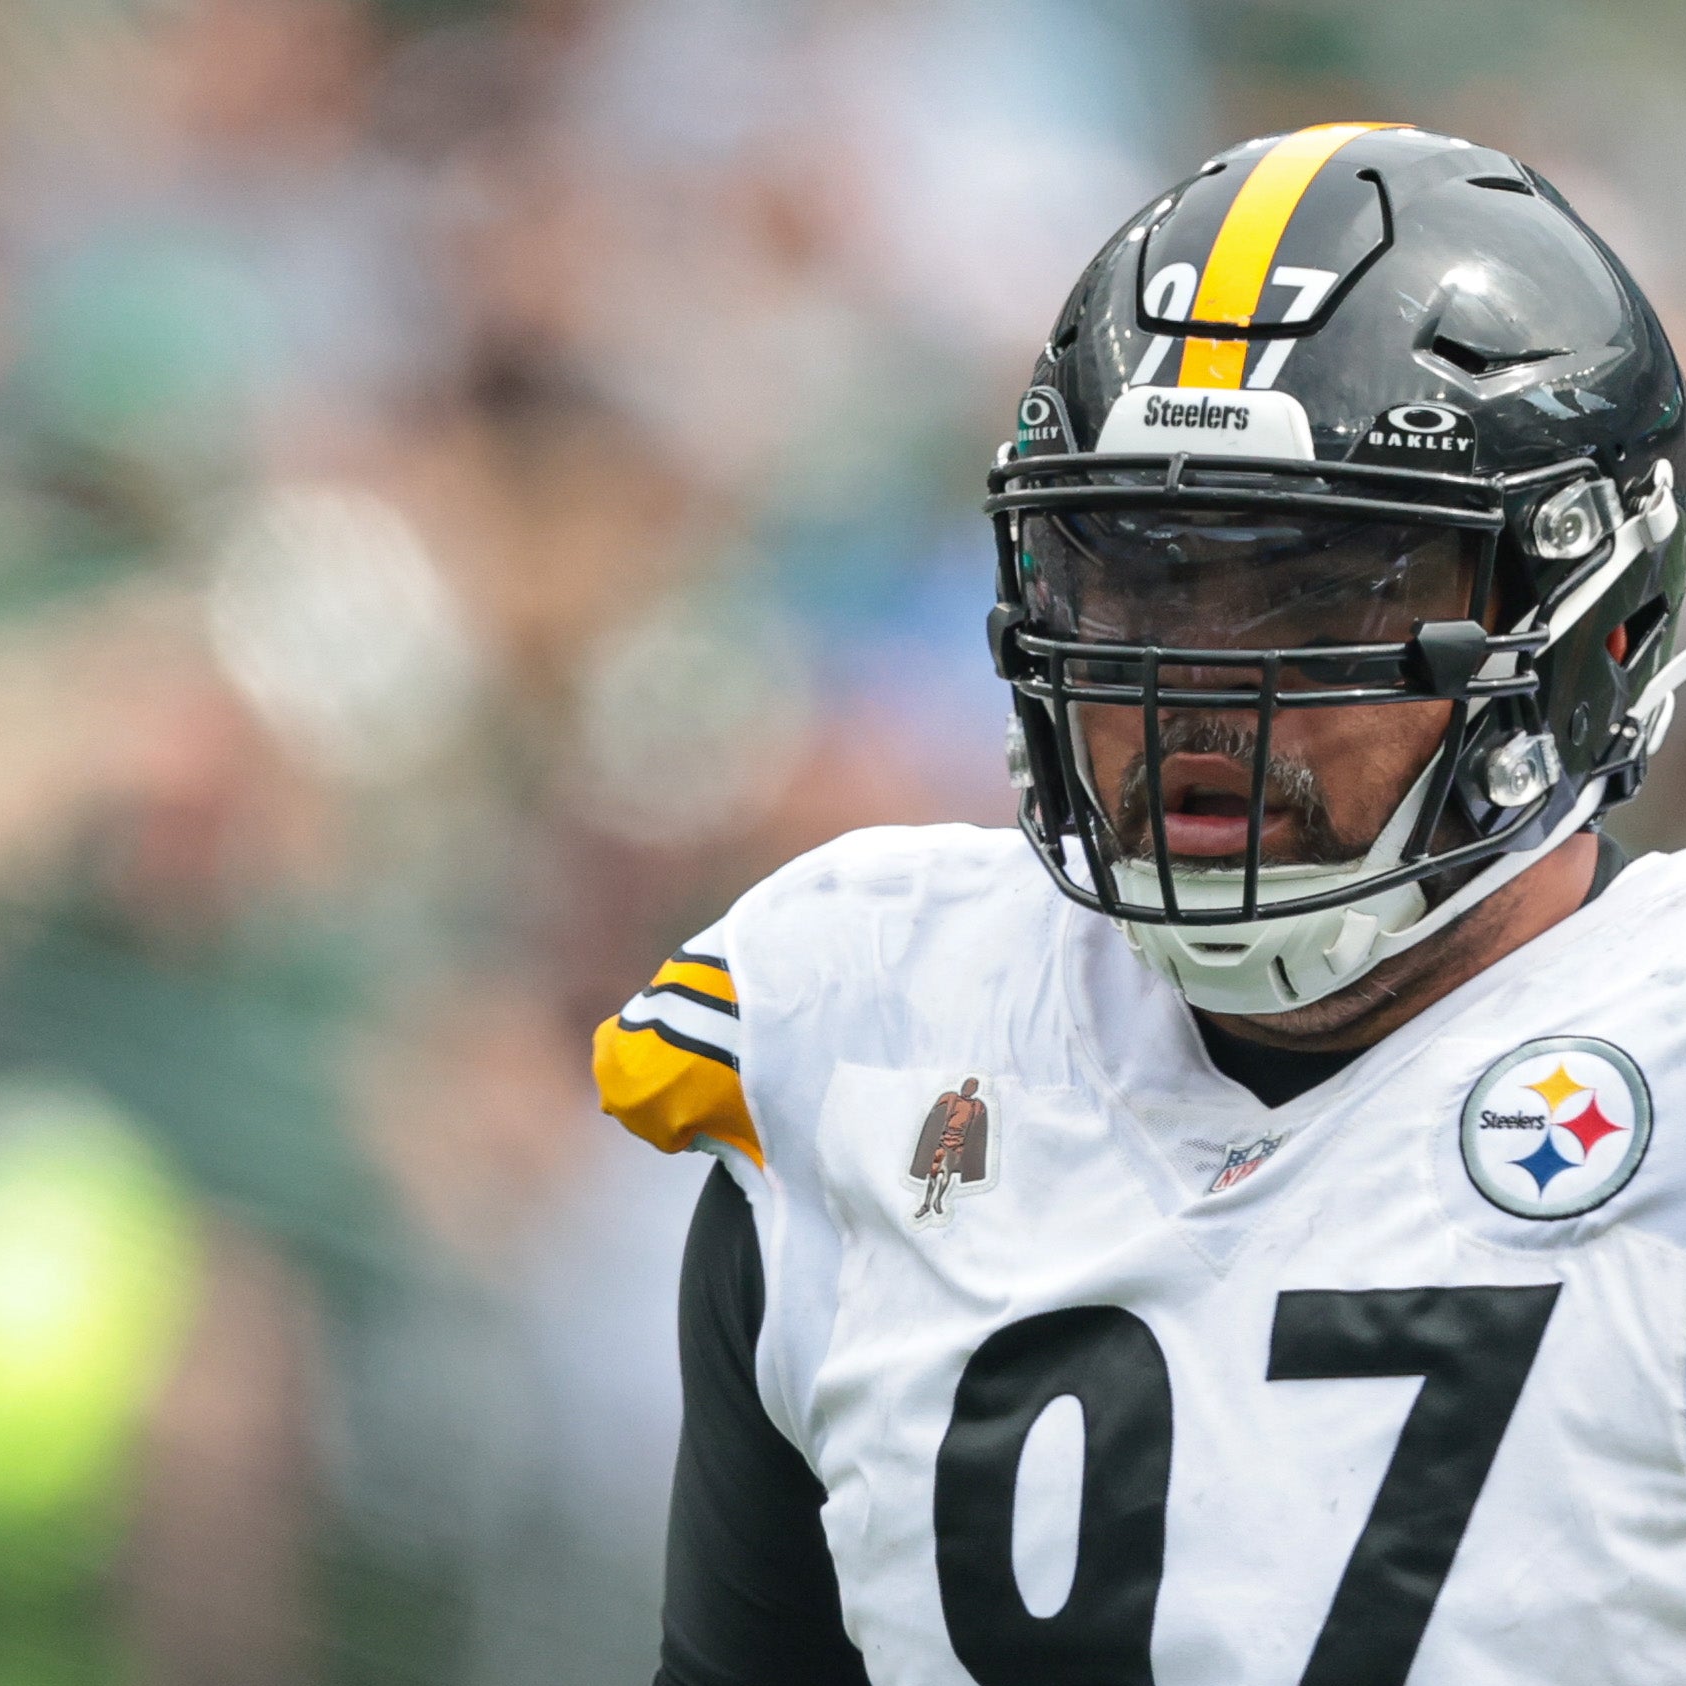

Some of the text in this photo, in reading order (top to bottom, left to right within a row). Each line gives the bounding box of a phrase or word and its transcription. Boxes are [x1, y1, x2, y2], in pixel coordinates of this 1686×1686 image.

[1129, 262, 1339, 390] 97
[1143, 393, 1251, 432] Steelers
[1367, 431, 1472, 452] OAKLEY
[1479, 1109, 1545, 1131] Steelers
